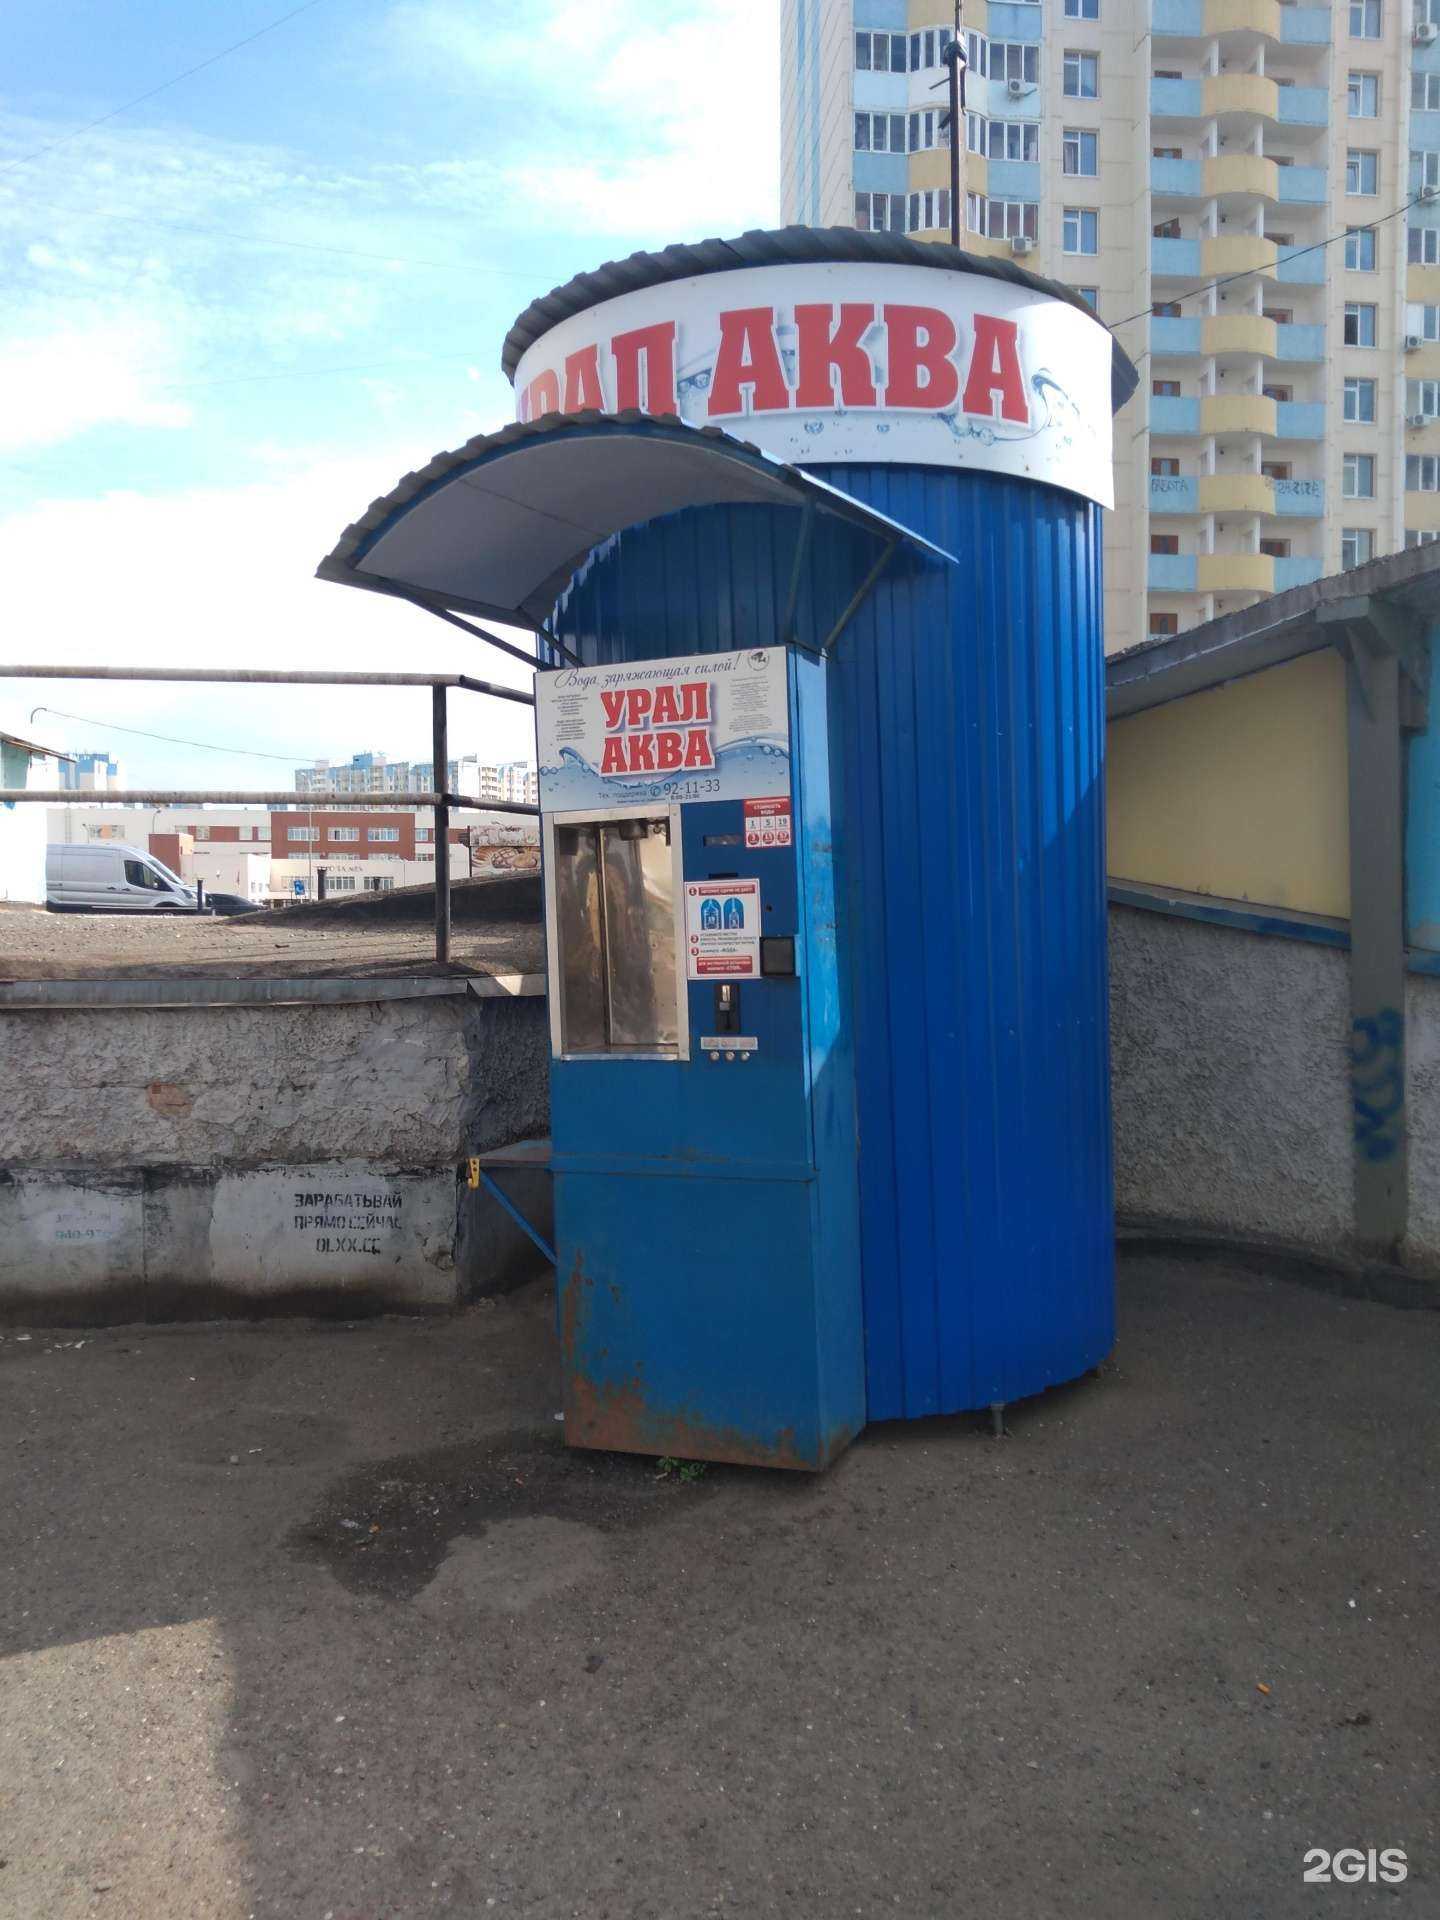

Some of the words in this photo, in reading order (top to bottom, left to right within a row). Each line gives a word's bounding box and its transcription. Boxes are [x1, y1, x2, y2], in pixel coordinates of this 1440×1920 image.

[707, 303, 1029, 424] АКВА
[601, 663, 690, 689] заряжающая
[694, 651, 743, 675] силой!
[600, 681, 710, 729] УРАЛ
[600, 728, 713, 774] АКВА
[663, 778, 721, 796] 92-11-33
[294, 1190, 403, 1208] ЗАРАБАТЫВАЙ
[294, 1215, 346, 1230] ПРЯМО
